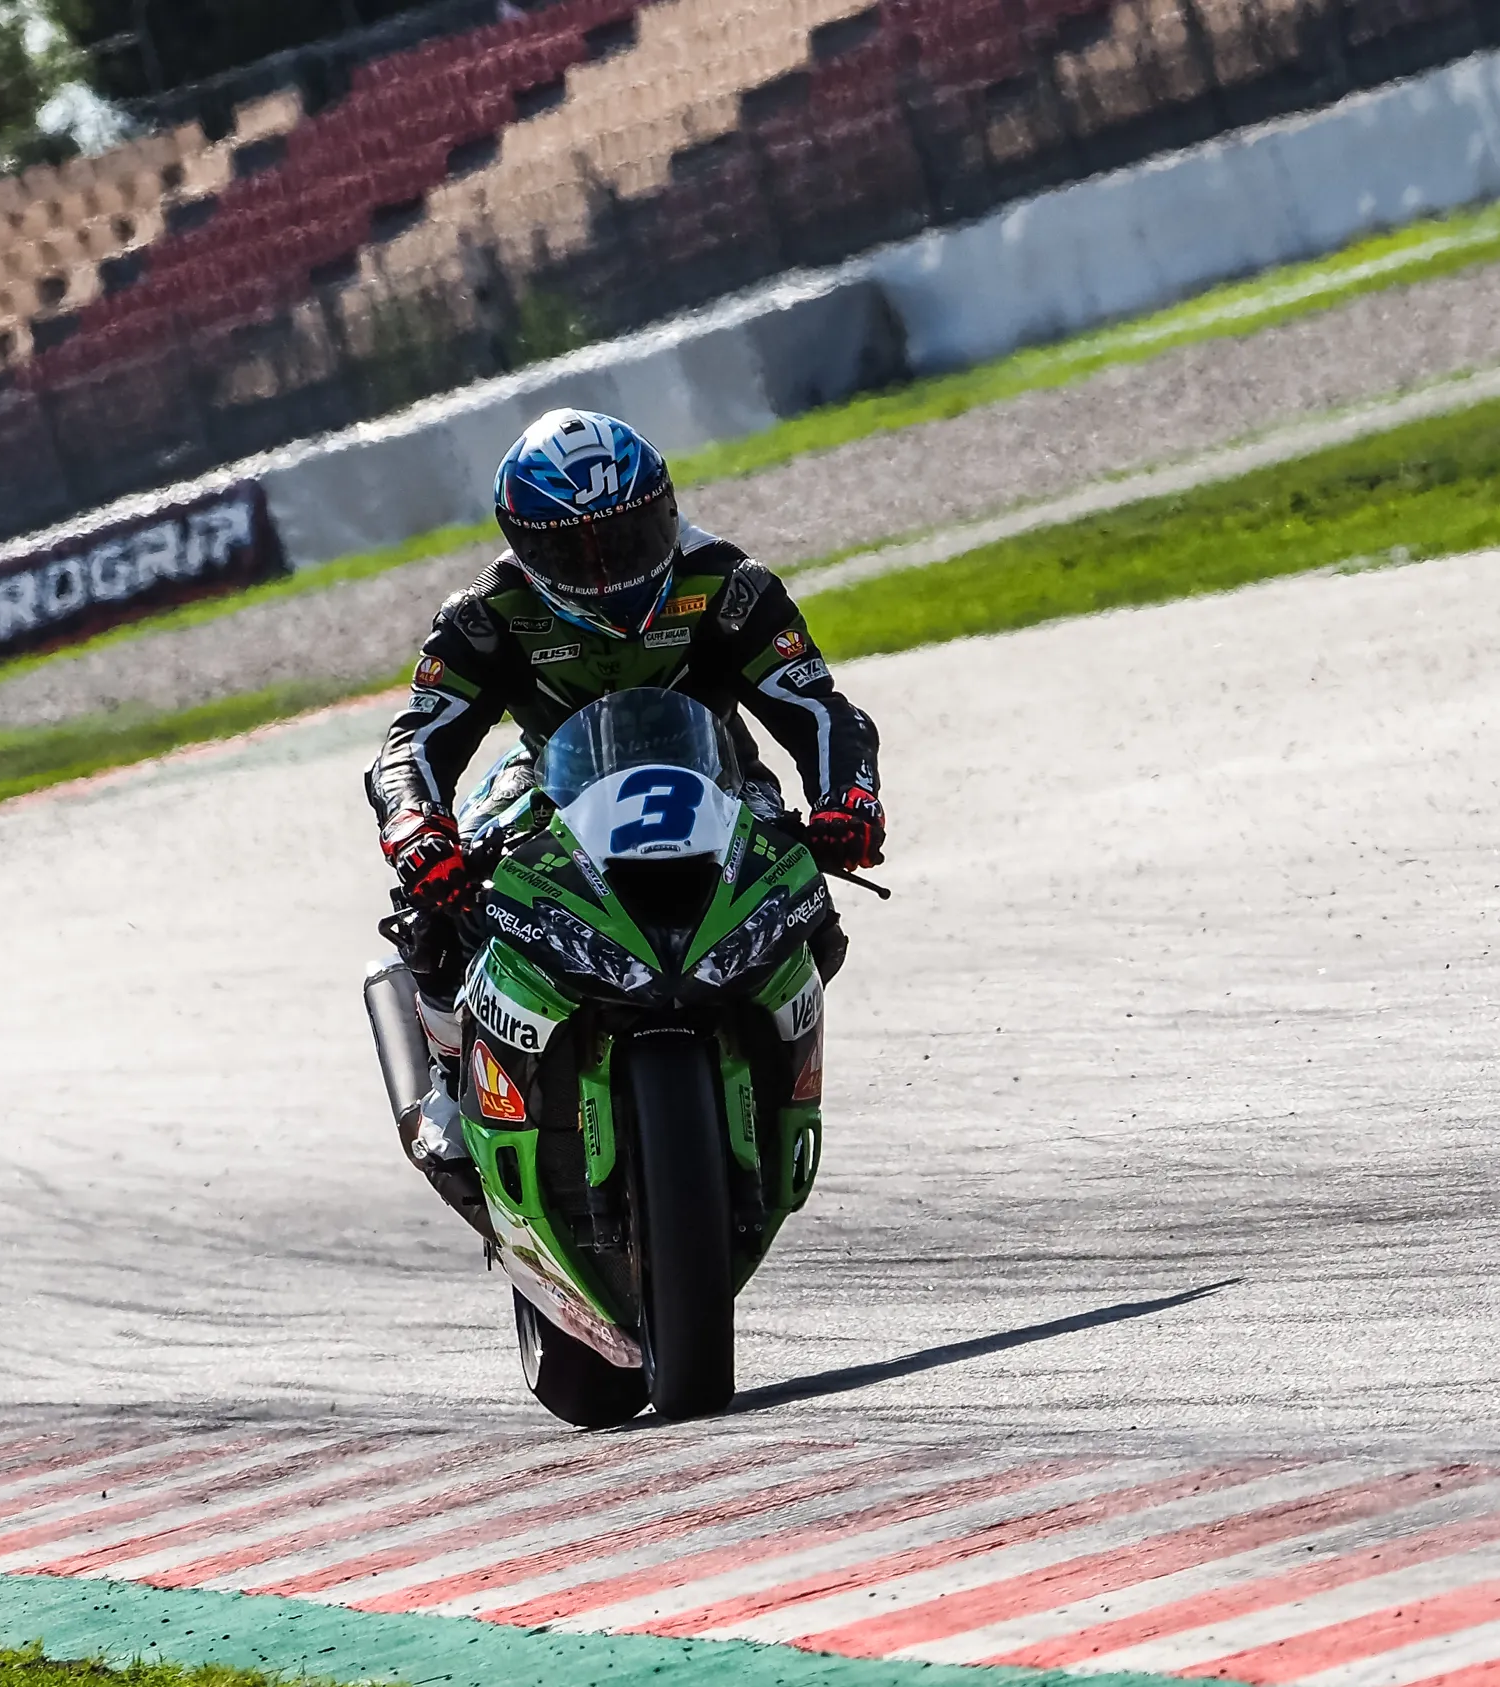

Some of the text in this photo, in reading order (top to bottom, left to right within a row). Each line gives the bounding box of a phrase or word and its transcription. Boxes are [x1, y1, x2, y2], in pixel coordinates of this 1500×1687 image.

[530, 521, 547, 530] ALS
[559, 516, 580, 528] ALS
[592, 507, 614, 520] ALS
[625, 497, 643, 511] ALS
[651, 485, 663, 499] ALS
[787, 641, 804, 656] ALS
[419, 672, 435, 682] ALS
[609, 768, 705, 855] 3
[500, 859, 564, 899] VerdNatura
[762, 847, 808, 886] VerdNatura
[486, 903, 544, 940] ORELAC
[786, 885, 826, 928] ORELAC
[482, 1091, 516, 1114] ALS
